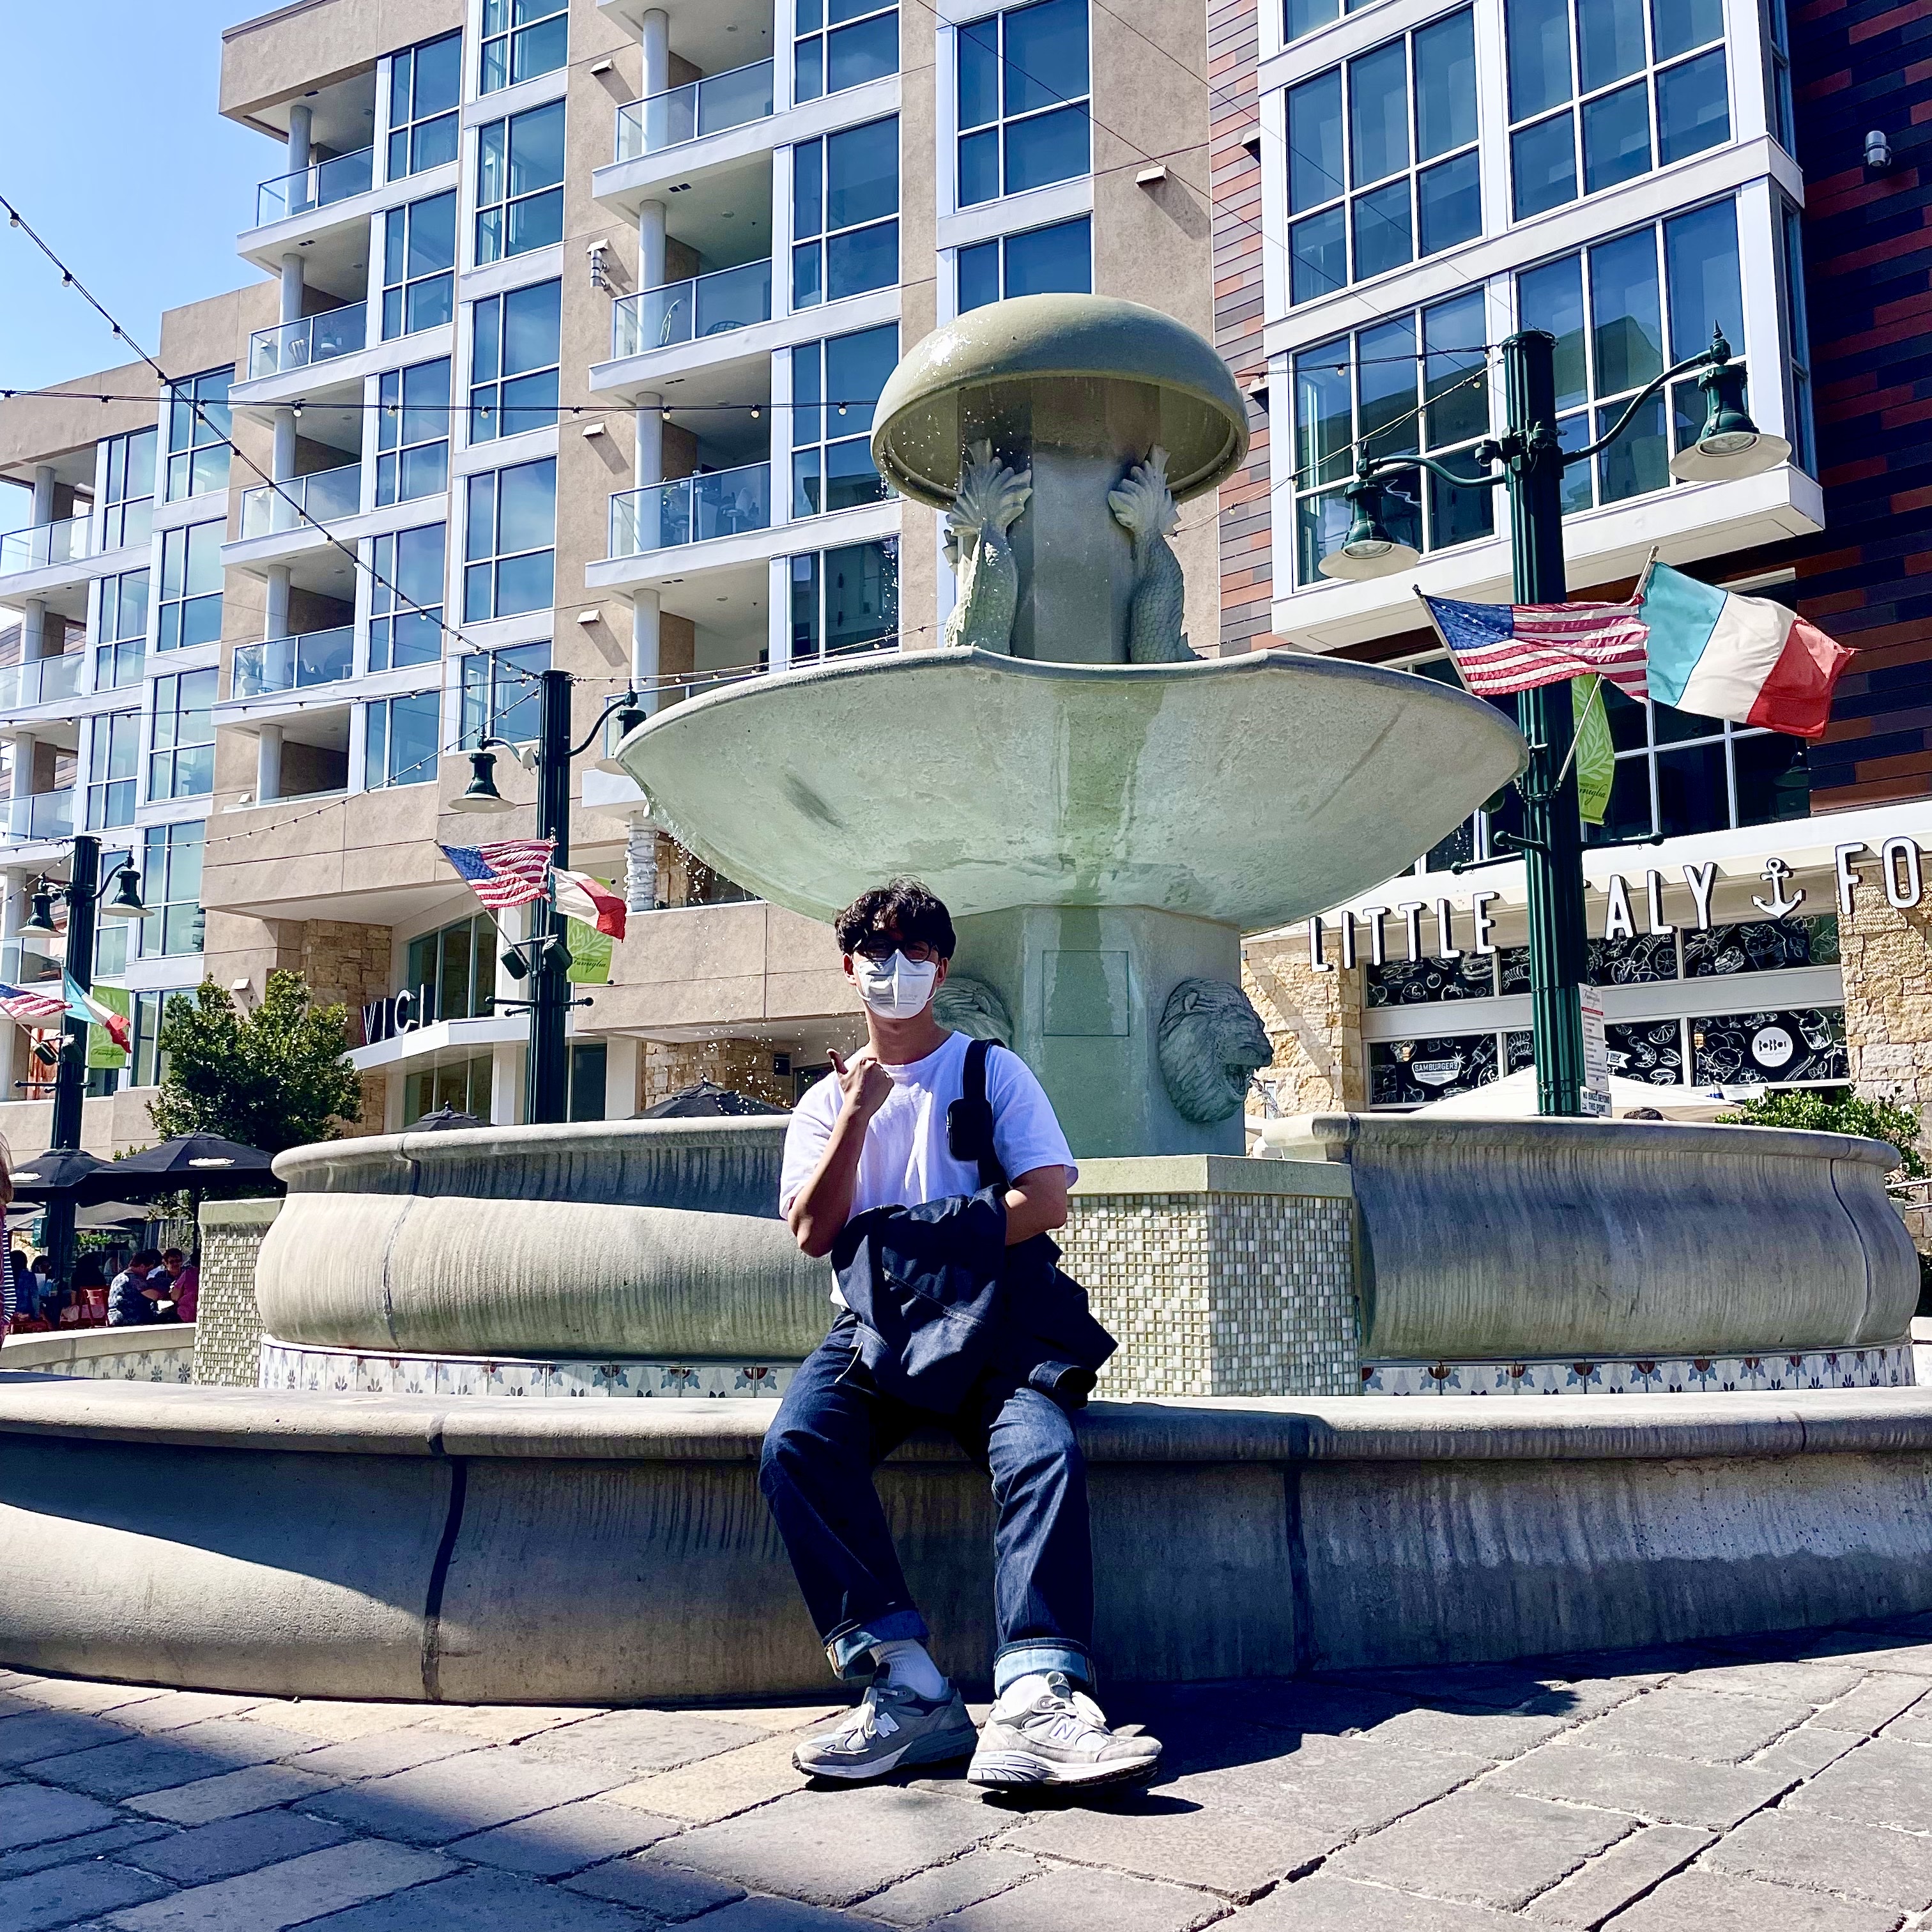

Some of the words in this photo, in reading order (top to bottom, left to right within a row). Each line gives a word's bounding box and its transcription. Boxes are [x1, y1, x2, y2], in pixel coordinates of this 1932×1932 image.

[1309, 891, 1499, 972] LITTLE
[1583, 862, 1717, 940] ALY
[875, 1712, 900, 1738] N
[1049, 1719, 1078, 1743] N
